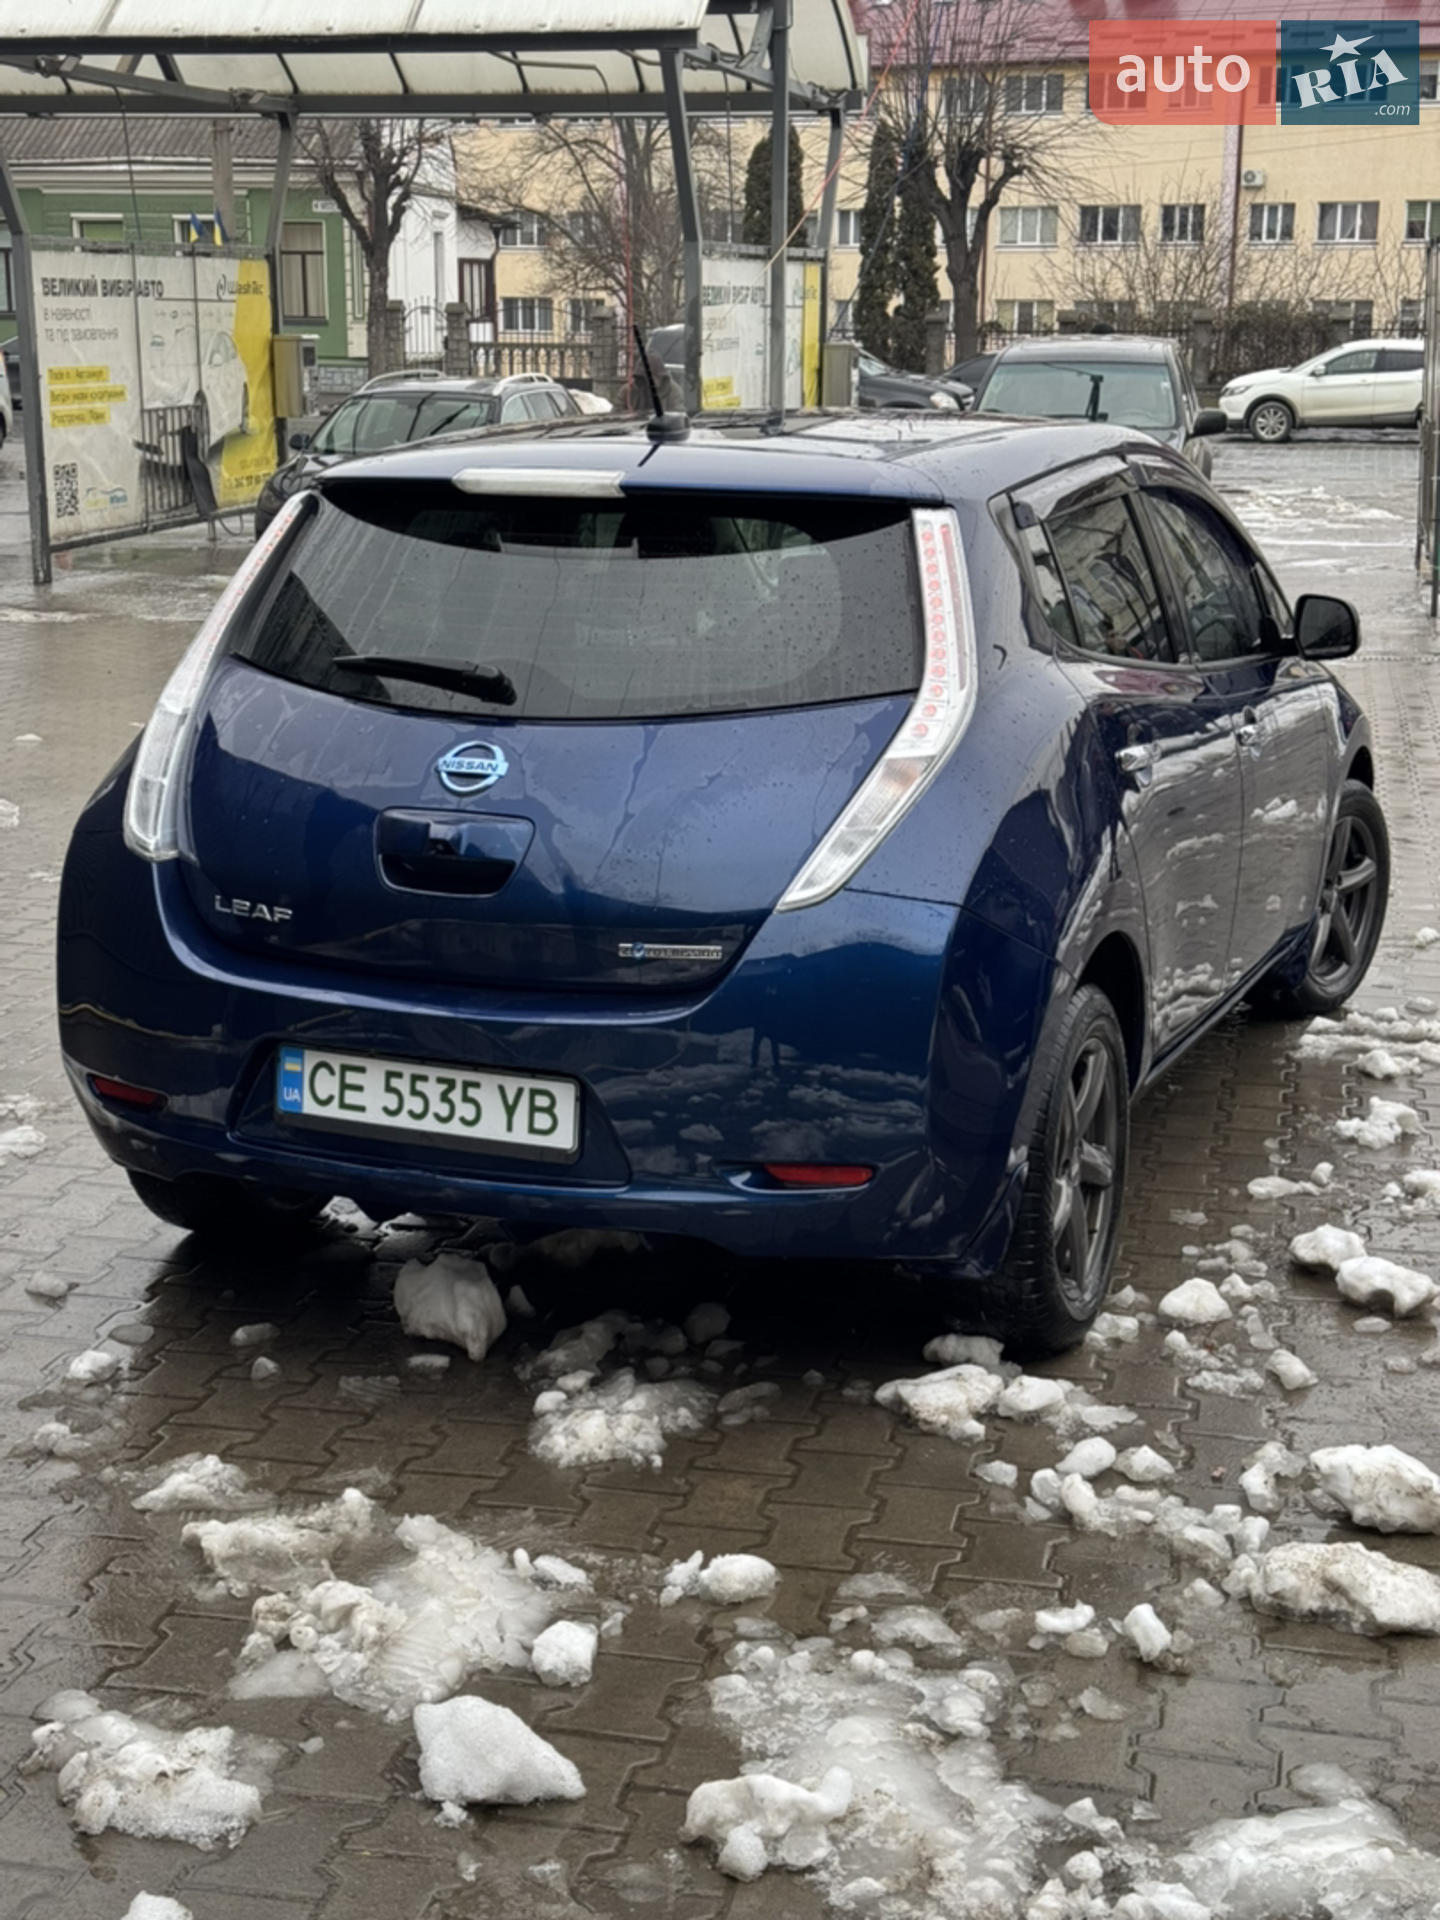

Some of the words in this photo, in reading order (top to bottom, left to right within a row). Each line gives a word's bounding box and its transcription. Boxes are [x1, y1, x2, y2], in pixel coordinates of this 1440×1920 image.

[41, 274, 98, 297] ВЕЛИКИЙ
[101, 278, 134, 297] ВИБІР
[135, 279, 164, 298] АВТО
[440, 760, 499, 772] NISSAN
[215, 895, 293, 923] LEAF
[283, 1086, 301, 1103] UA
[308, 1060, 367, 1113] CE
[381, 1069, 482, 1127] 5535
[497, 1083, 559, 1136] YB
